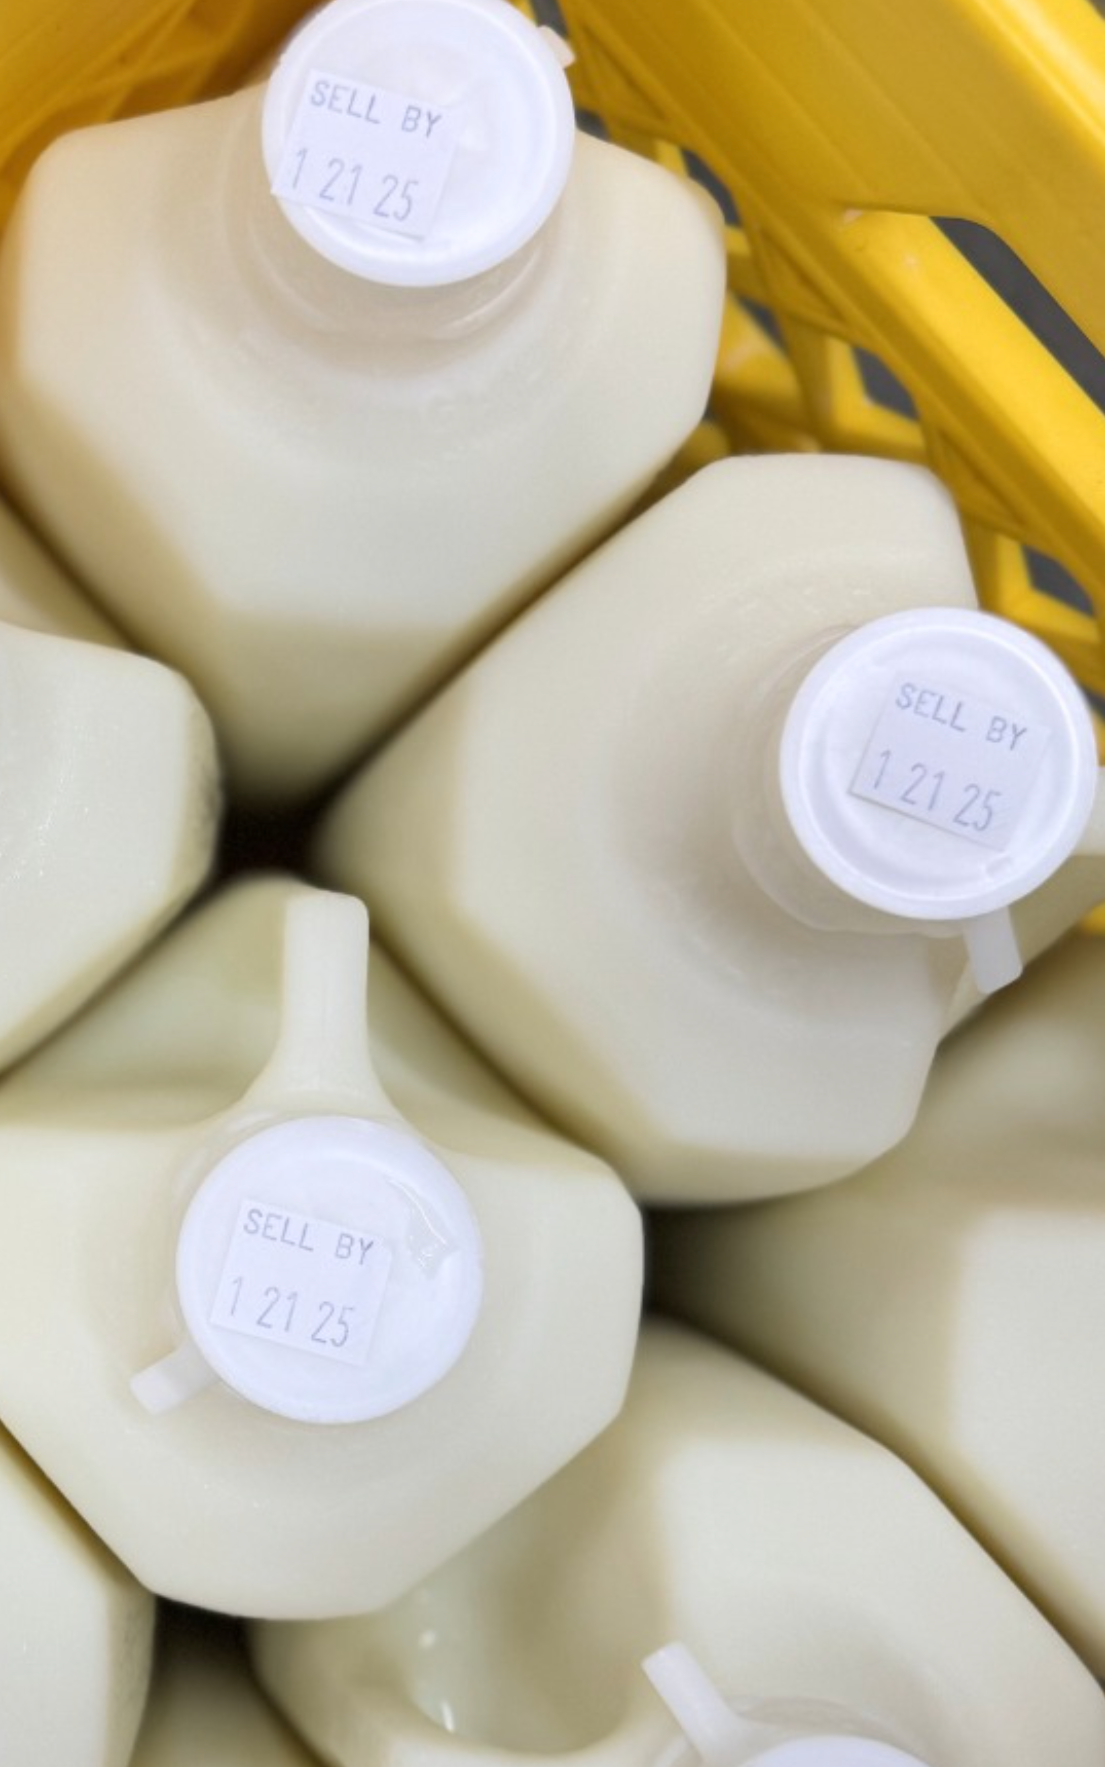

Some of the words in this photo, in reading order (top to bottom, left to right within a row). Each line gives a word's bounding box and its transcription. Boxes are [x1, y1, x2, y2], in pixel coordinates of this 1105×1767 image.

[309, 79, 381, 125] SELL
[401, 104, 442, 138] BY
[292, 147, 308, 190] 1
[319, 157, 363, 206] 21
[373, 174, 419, 222] 25
[895, 682, 966, 732] SELL
[986, 715, 1027, 751] BY
[873, 749, 891, 789] 1
[900, 762, 946, 811] 21
[953, 783, 1002, 832] 25
[244, 1208, 314, 1252] SELL
[334, 1232, 374, 1266] BY
[230, 1276, 243, 1316] 1
[256, 1286, 299, 1332] 21
[311, 1301, 356, 1348] 25
